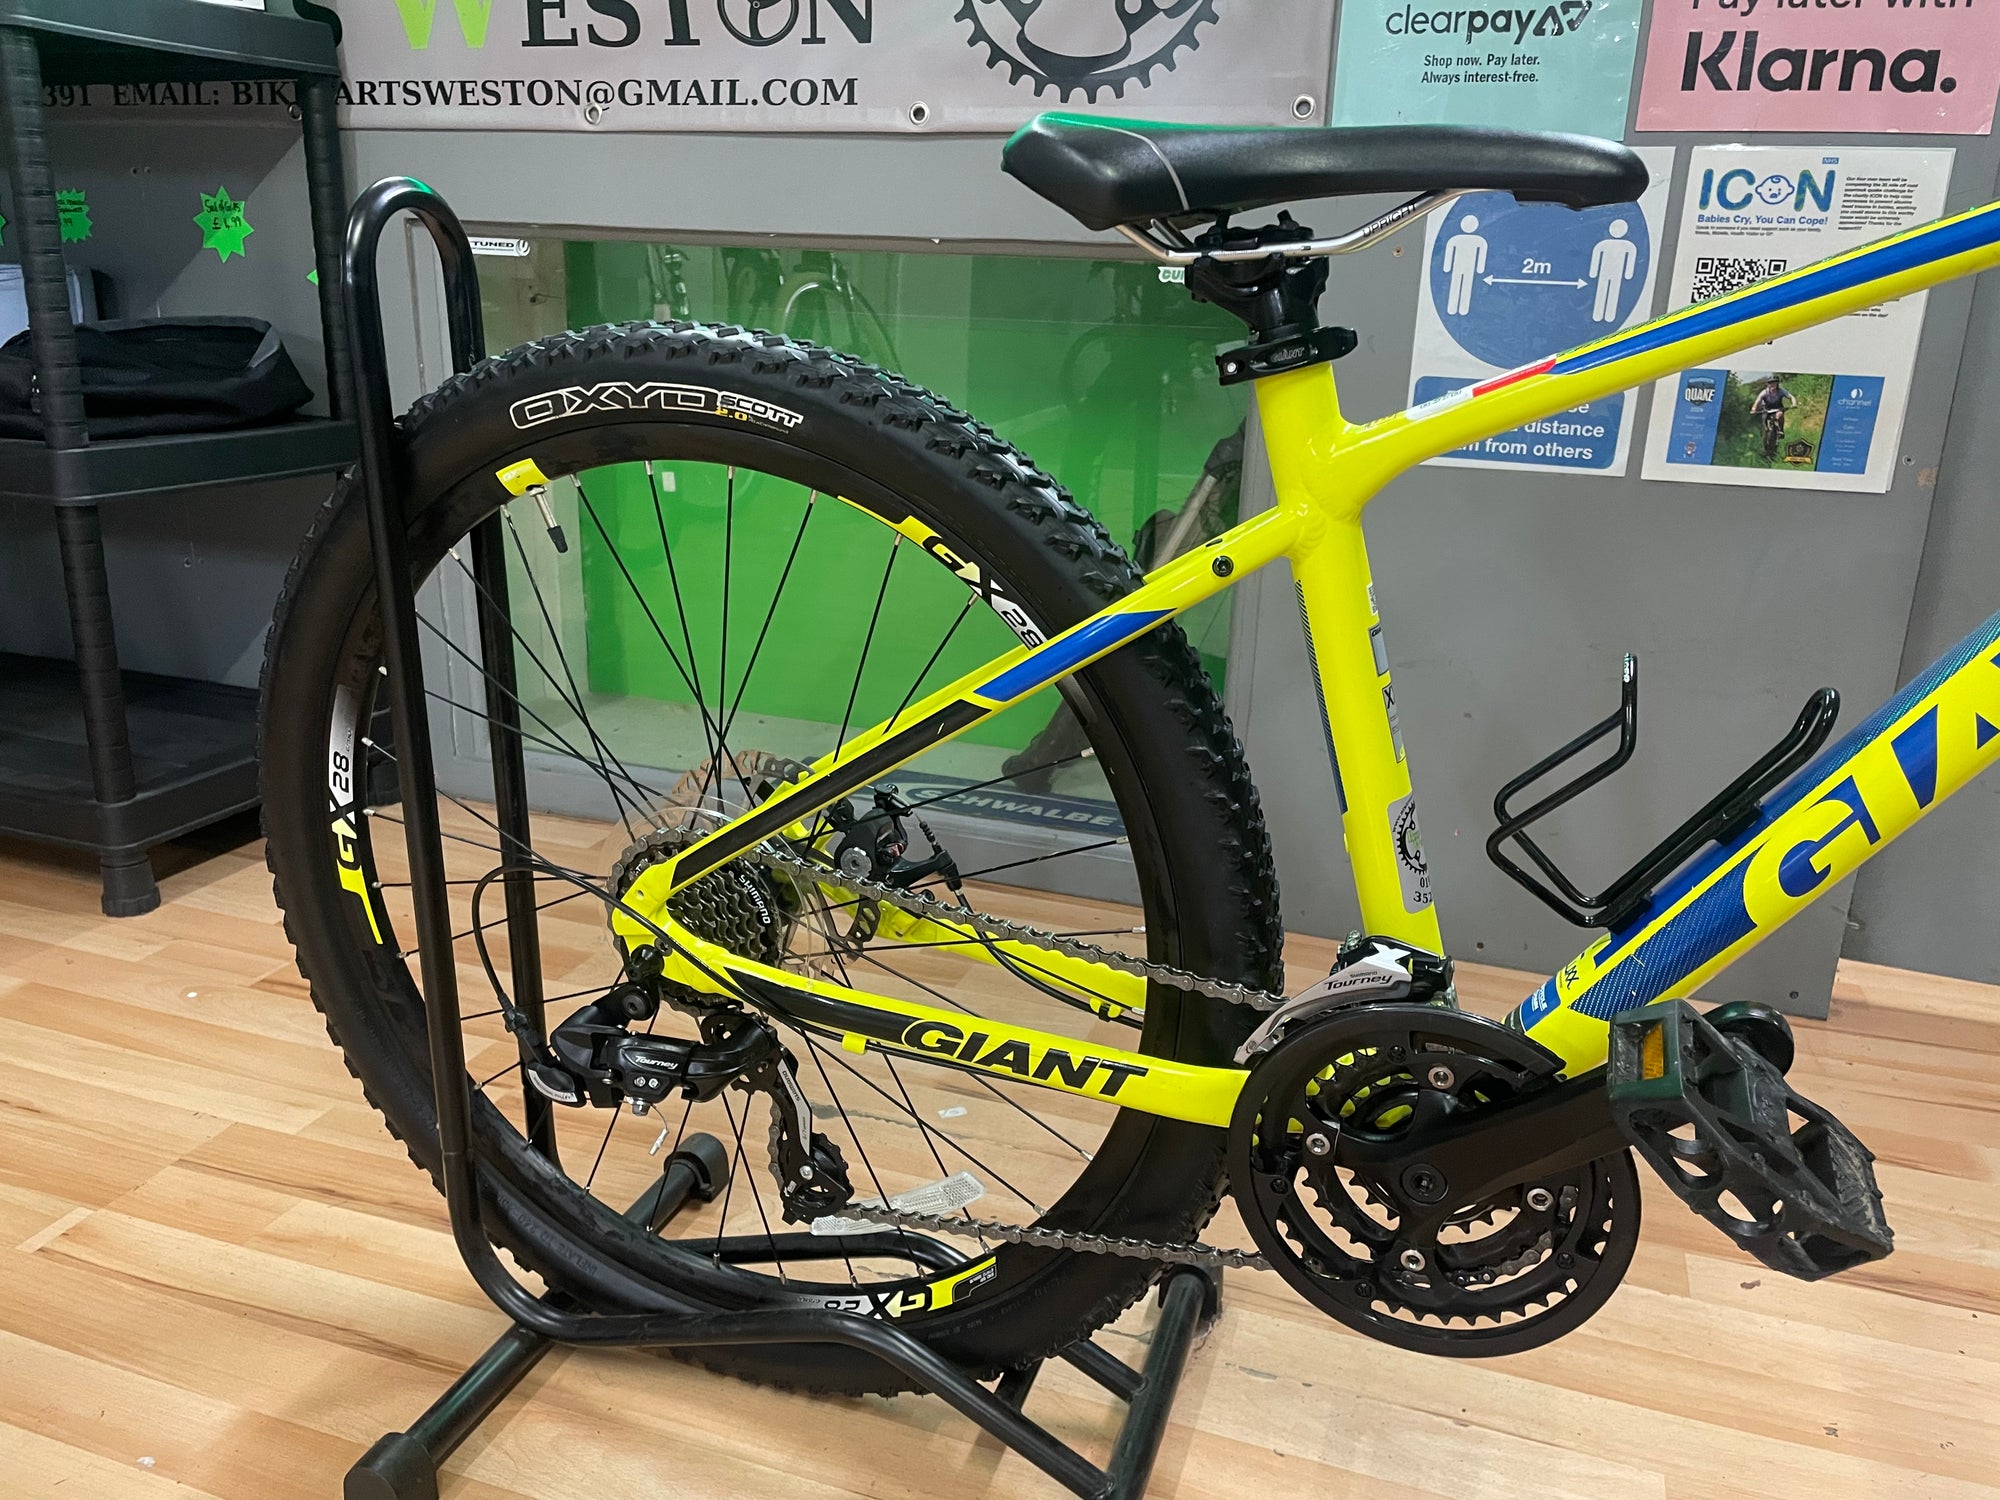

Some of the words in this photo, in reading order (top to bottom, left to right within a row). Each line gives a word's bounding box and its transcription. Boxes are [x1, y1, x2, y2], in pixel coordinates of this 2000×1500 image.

[1385, 3, 1537, 45] clearpay
[1423, 54, 1452, 69] Shop
[1456, 56, 1482, 67] now.
[1487, 54, 1508, 68] Pay
[1511, 53, 1540, 66] later.
[1680, 30, 1957, 94] Klarna.
[1421, 71, 1461, 85] Always
[1463, 70, 1539, 84] interest-free.
[231, 78, 859, 110] BIKARTSWESTON@GMAIL.COM
[1697, 214, 1731, 223] Babies
[1733, 214, 1752, 225] Cry,
[1755, 215, 1774, 224] You
[1776, 215, 1796, 224] Can
[1798, 216, 1829, 226] Cope!
[1521, 258, 1551, 275] 2m
[1684, 387, 1716, 402] QUAKE
[714, 405, 748, 422] 2.0
[719, 391, 804, 428] SCOTT
[1524, 419, 1605, 438] distance
[1485, 437, 1528, 455] from
[1533, 442, 1593, 460] others
[1000, 608, 1044, 651] 28
[333, 751, 350, 793] 28
[914, 789, 1118, 827] SCHWALBE
[738, 874, 772, 925] SHIMANO
[1325, 974, 1393, 991] Tourney
[634, 1055, 680, 1070] Tourney
[902, 1019, 1149, 1098] GIANT
